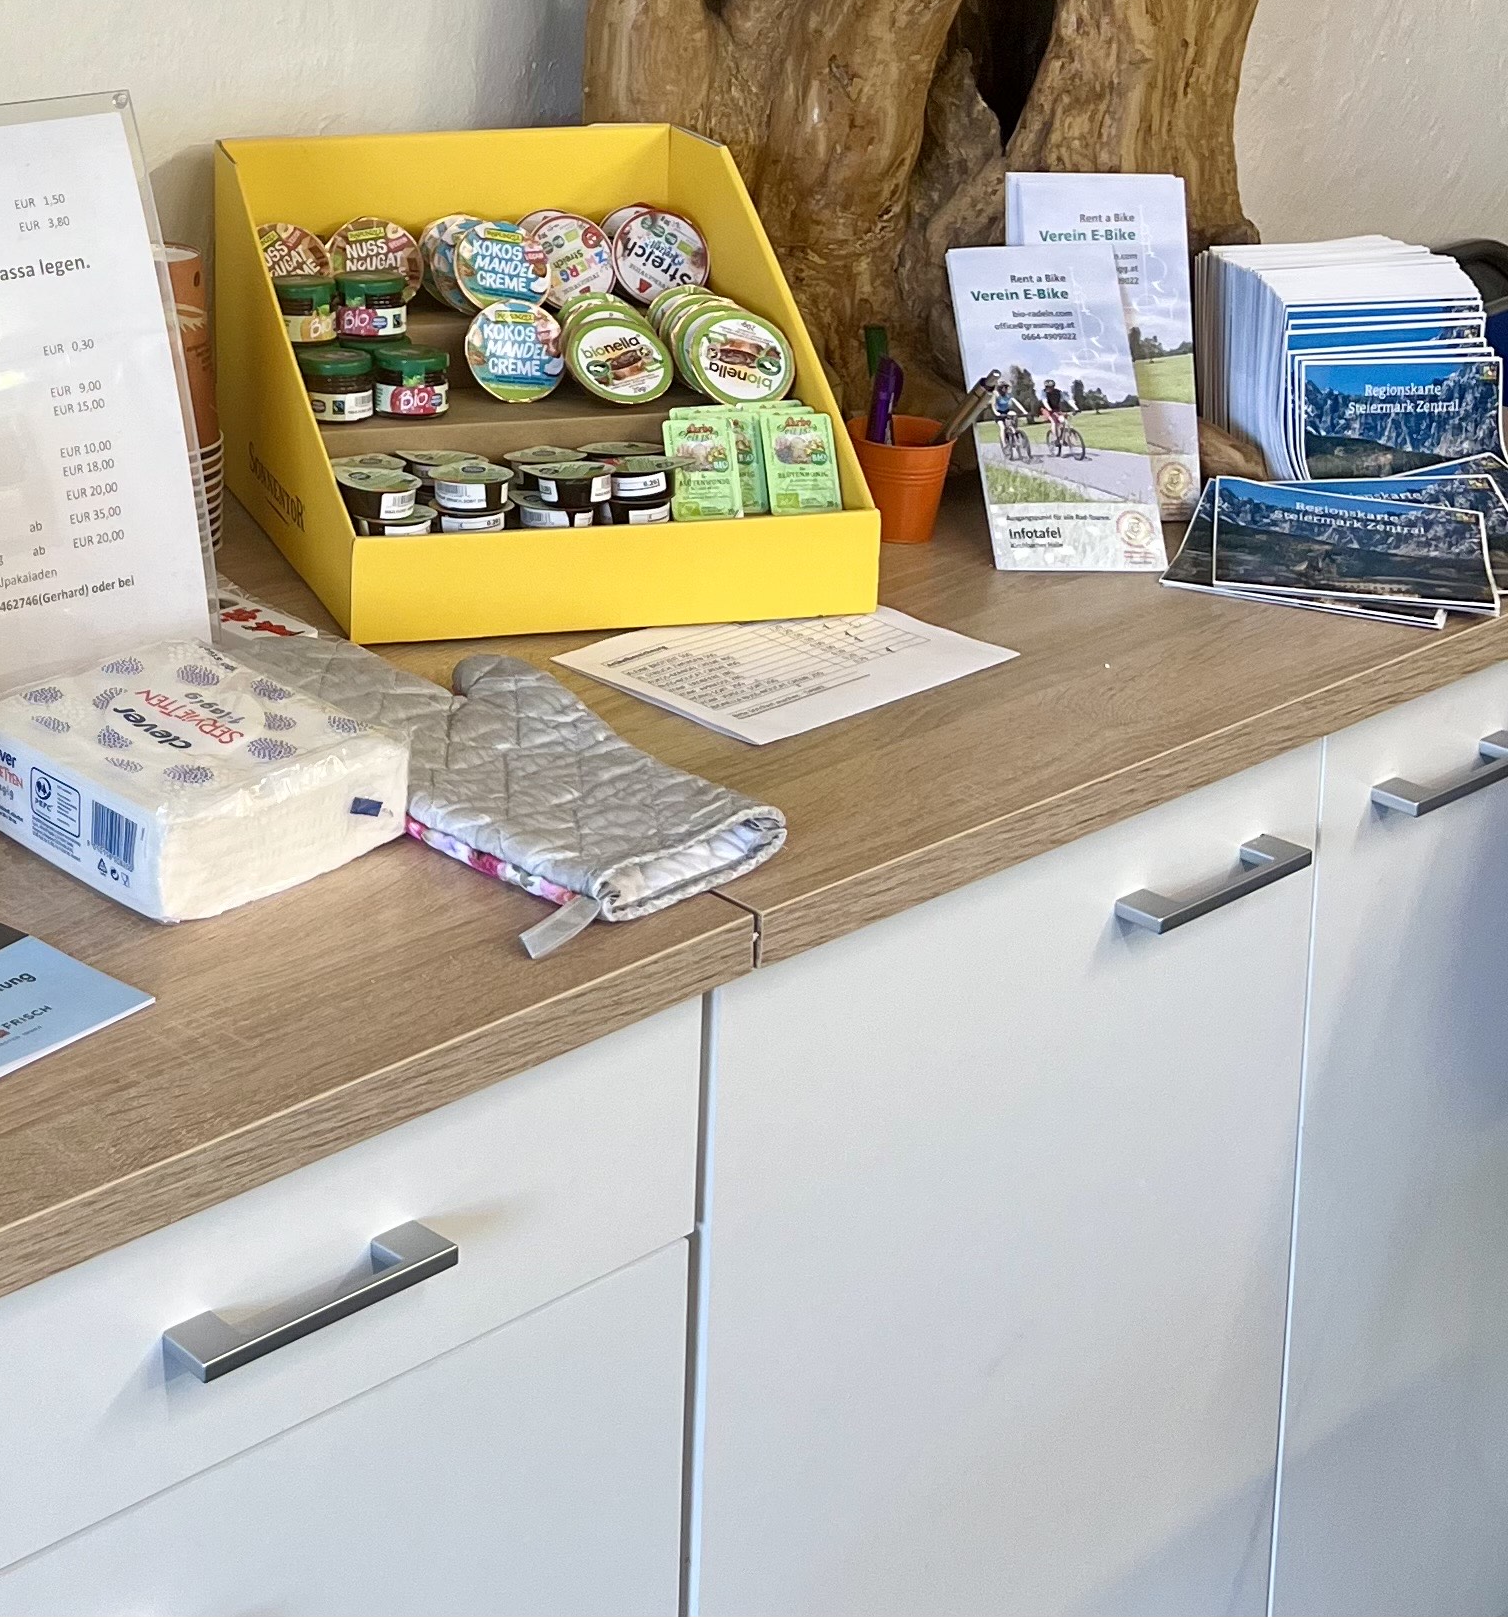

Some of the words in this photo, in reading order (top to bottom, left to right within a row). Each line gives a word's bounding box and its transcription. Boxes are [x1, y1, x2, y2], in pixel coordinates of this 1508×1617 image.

[13, 196, 36, 210] EUR
[42, 192, 66, 206] 1,50
[18, 219, 41, 233] EUR
[47, 215, 70, 229] 3,80
[1079, 214, 1103, 223] Rent
[1105, 215, 1111, 223] a
[1113, 213, 1135, 223] Bike
[1039, 229, 1087, 242] Verein
[1091, 229, 1136, 241] E-Bike
[345, 238, 388, 259] NUSS
[473, 239, 522, 261] KOKOS
[38, 257, 91, 277] legen.
[475, 256, 536, 278] MANDEL
[476, 271, 528, 292] CREME
[1010, 274, 1034, 283] Rent
[1045, 273, 1066, 283] Bike
[971, 289, 1019, 302] Verein
[1023, 288, 1069, 300] E-Bike
[483, 324, 536, 341] KOKOS
[42, 342, 65, 357] EUR
[70, 337, 95, 352] 0,30
[486, 339, 549, 360] MANDEL
[580, 336, 641, 360] bionella
[488, 357, 541, 376] CREME
[708, 360, 773, 391] bionella
[1364, 383, 1442, 398] Regionskarte
[52, 402, 75, 417] EUR
[76, 397, 105, 413] 15,00
[1348, 401, 1414, 414] Steiermark
[1416, 399, 1459, 413] Zentral
[59, 444, 82, 459] EUR
[83, 439, 112, 455] 10,00
[65, 486, 88, 501] EUR
[89, 481, 118, 497] 20,00
[68, 510, 91, 525] EUR
[92, 504, 122, 521] 35,00
[1295, 501, 1399, 523] Regionskarte
[1272, 510, 1364, 530] Steiermark
[1365, 521, 1425, 535] Zentral
[72, 534, 95, 549] EUR
[95, 528, 125, 545] 20,00
[1008, 527, 1062, 540] Infotafel
[90, 580, 116, 594] oder
[117, 574, 135, 588] bei
[134, 689, 244, 744] SERVIETTEN
[113, 706, 192, 749] clever
[1, 1004, 52, 1030] FRISCH
